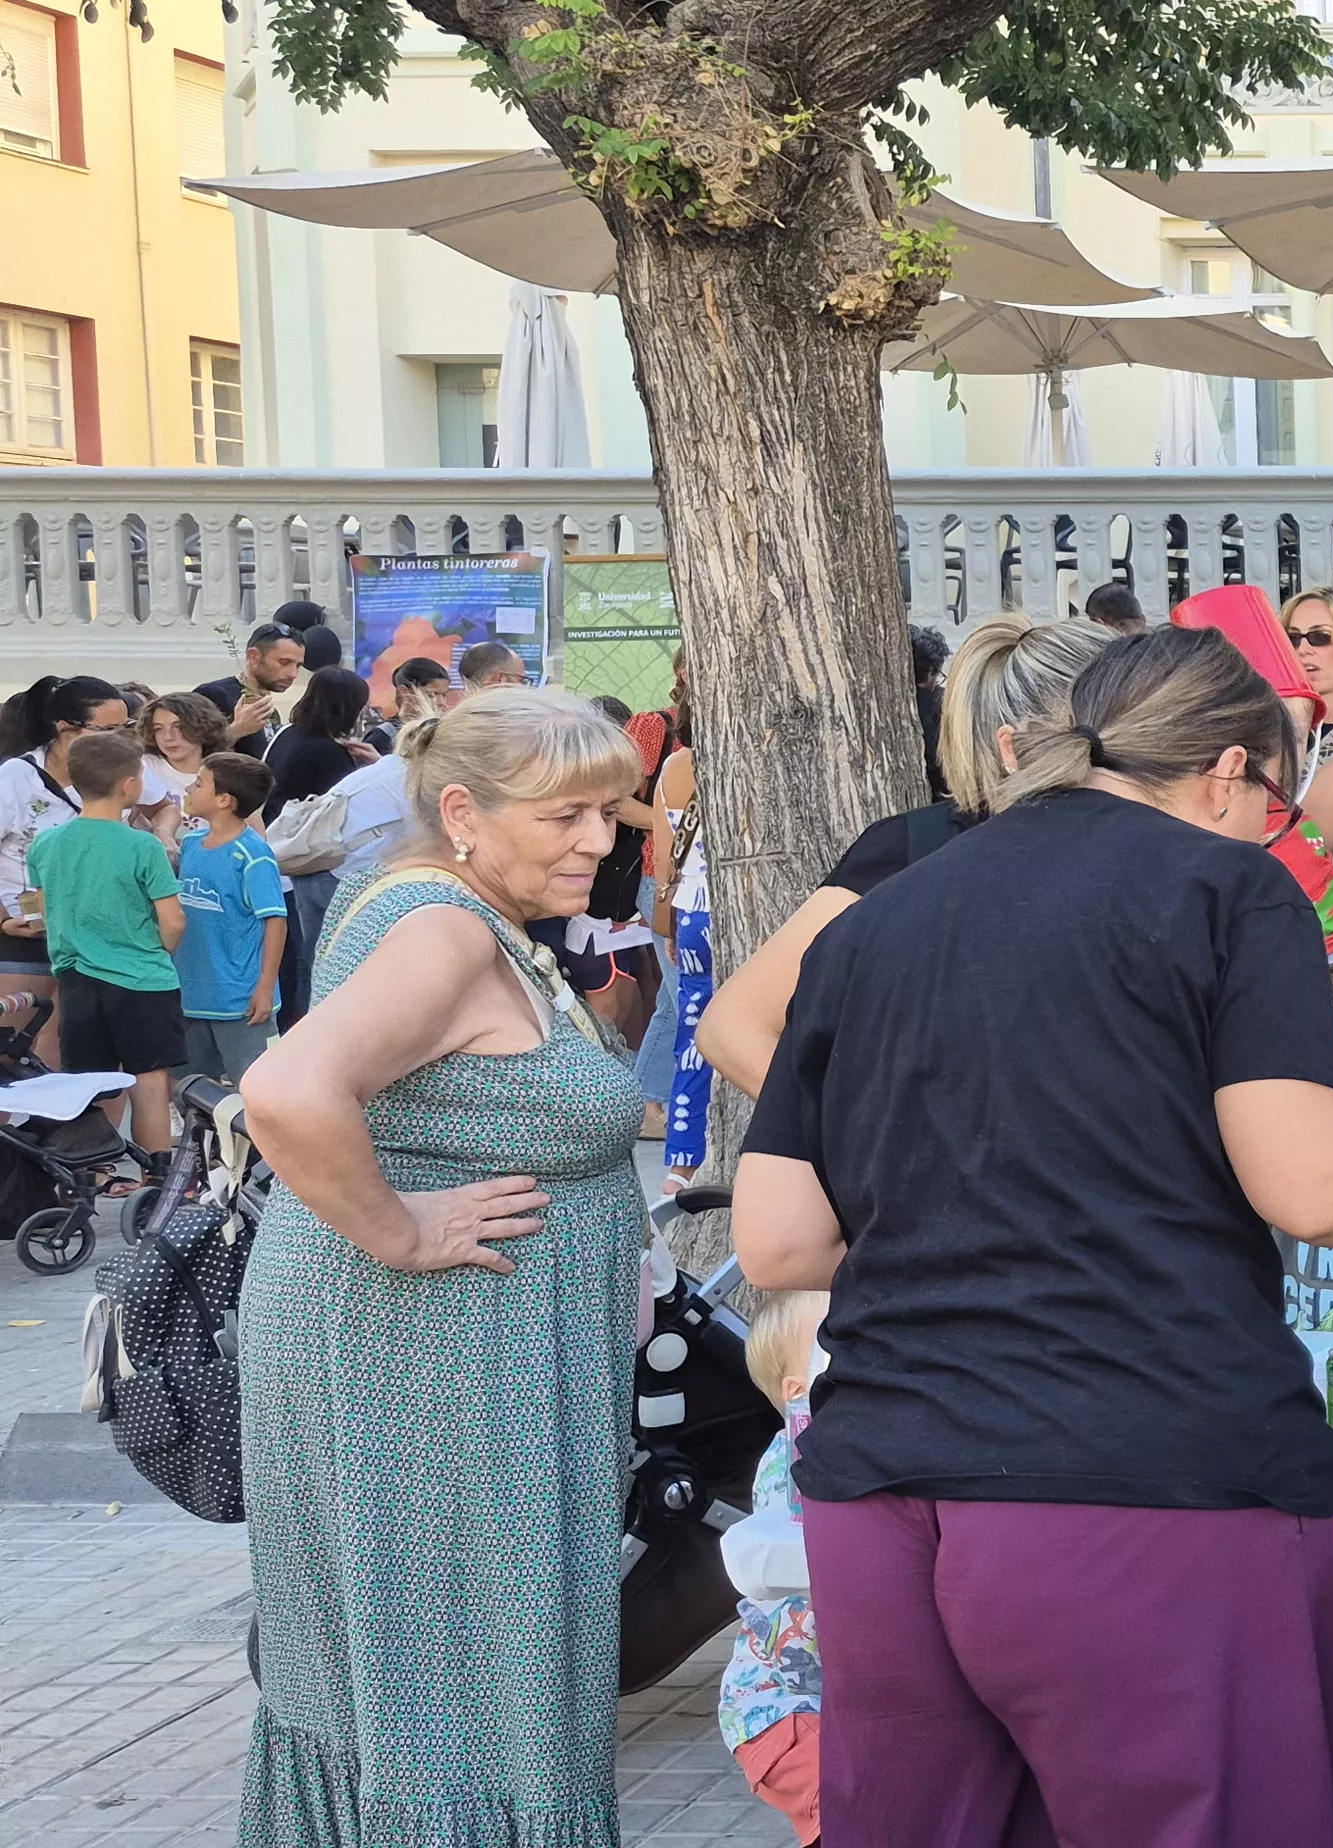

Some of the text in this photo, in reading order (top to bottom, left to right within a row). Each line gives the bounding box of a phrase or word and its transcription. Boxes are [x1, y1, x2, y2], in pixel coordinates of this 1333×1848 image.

[380, 556, 519, 571] Plantas tintoreras
[598, 591, 651, 601] Universidad
[567, 629, 627, 639] INVESTIGACIÓN
[628, 629, 649, 637] PARA
[650, 628, 663, 636] UN
